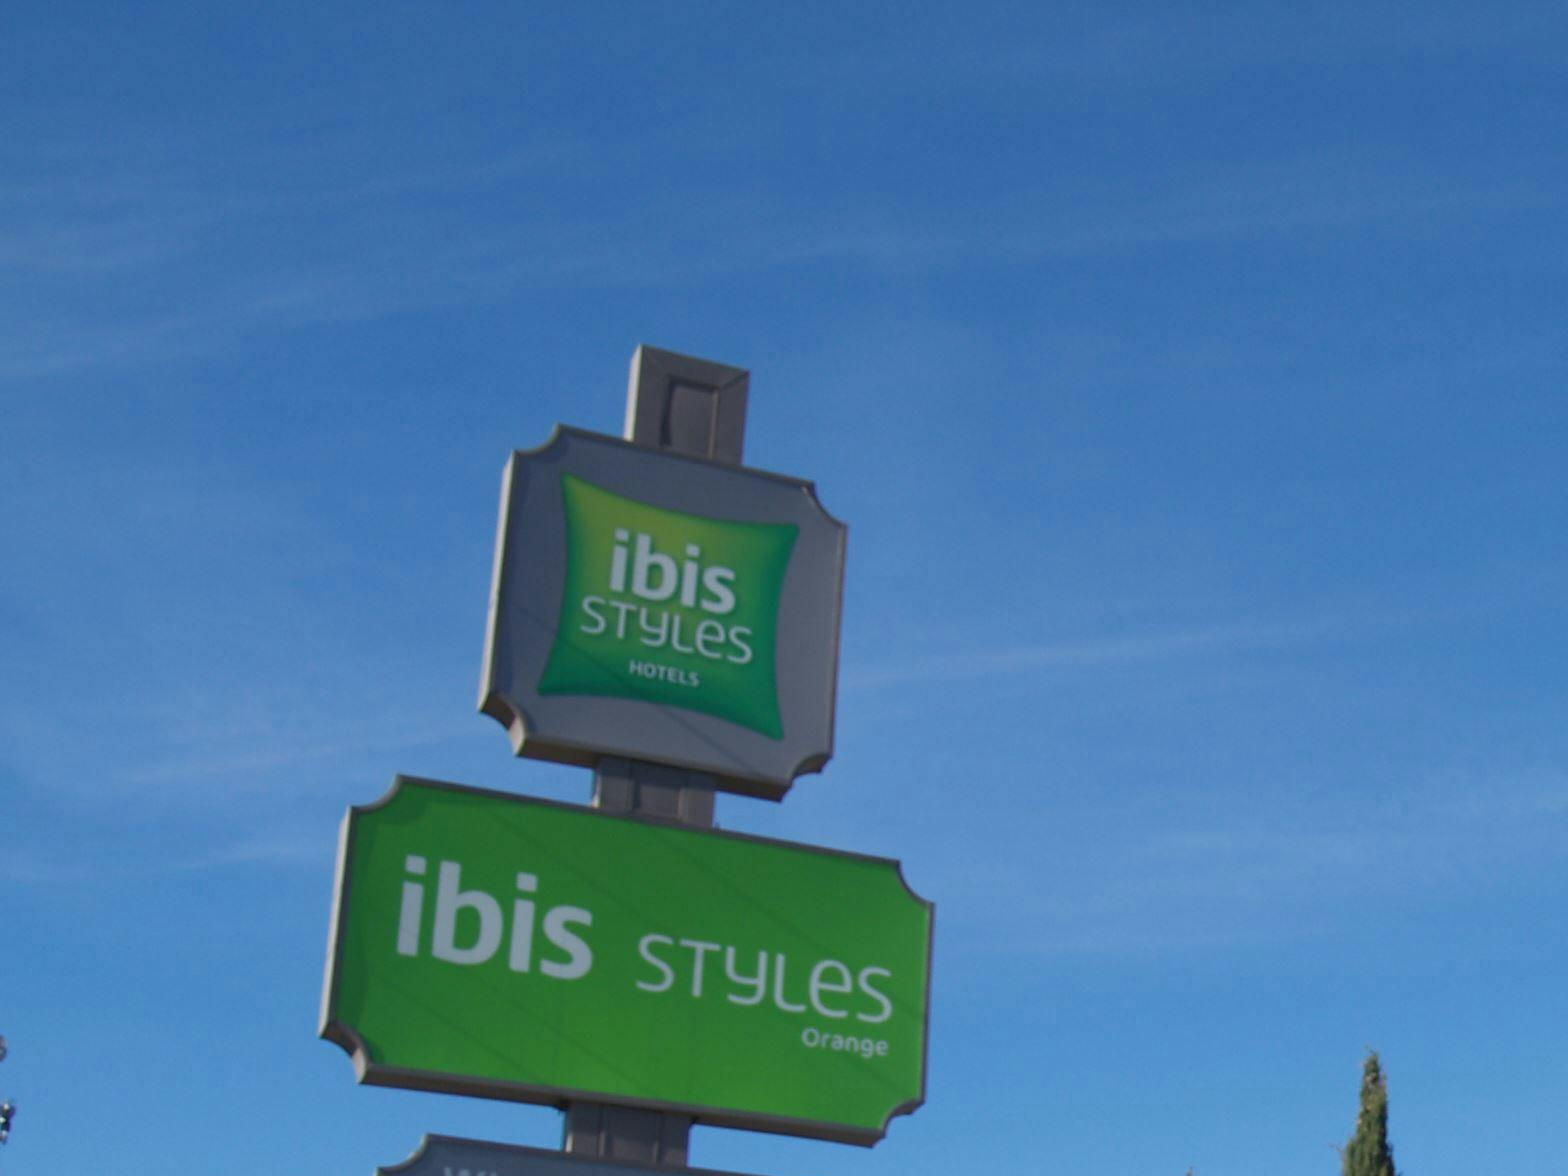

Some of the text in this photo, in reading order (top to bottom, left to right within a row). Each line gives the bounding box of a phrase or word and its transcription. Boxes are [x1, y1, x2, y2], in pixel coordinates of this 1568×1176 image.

[609, 528, 736, 614] ibis
[629, 659, 699, 687] HOTELS
[397, 854, 593, 979] ibis
[801, 1028, 888, 1058] Orange
